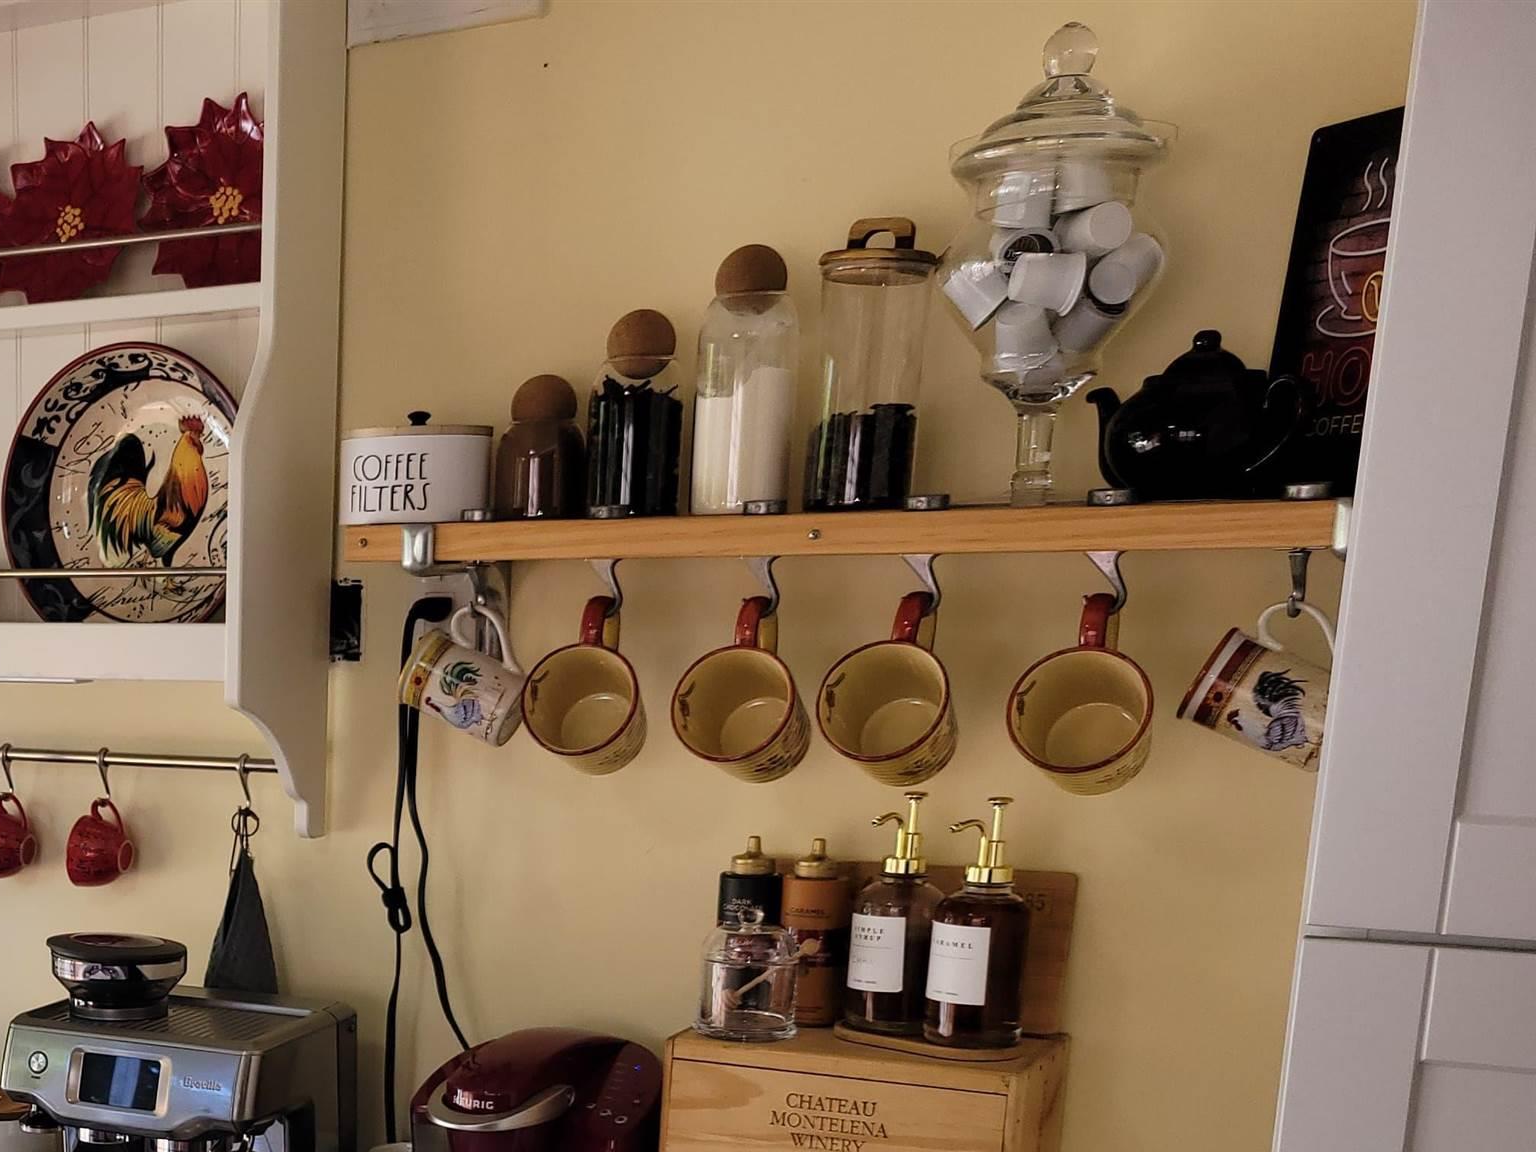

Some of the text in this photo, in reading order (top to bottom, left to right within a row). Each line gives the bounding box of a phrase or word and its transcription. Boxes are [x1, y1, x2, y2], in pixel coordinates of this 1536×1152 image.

[1301, 346, 1370, 408] HO
[1305, 412, 1364, 437] OFFE
[353, 452, 430, 482] COFFEE
[350, 482, 432, 513] FILTERS
[786, 1092, 877, 1117] CHATEAU
[769, 1110, 888, 1138] MONTELENA
